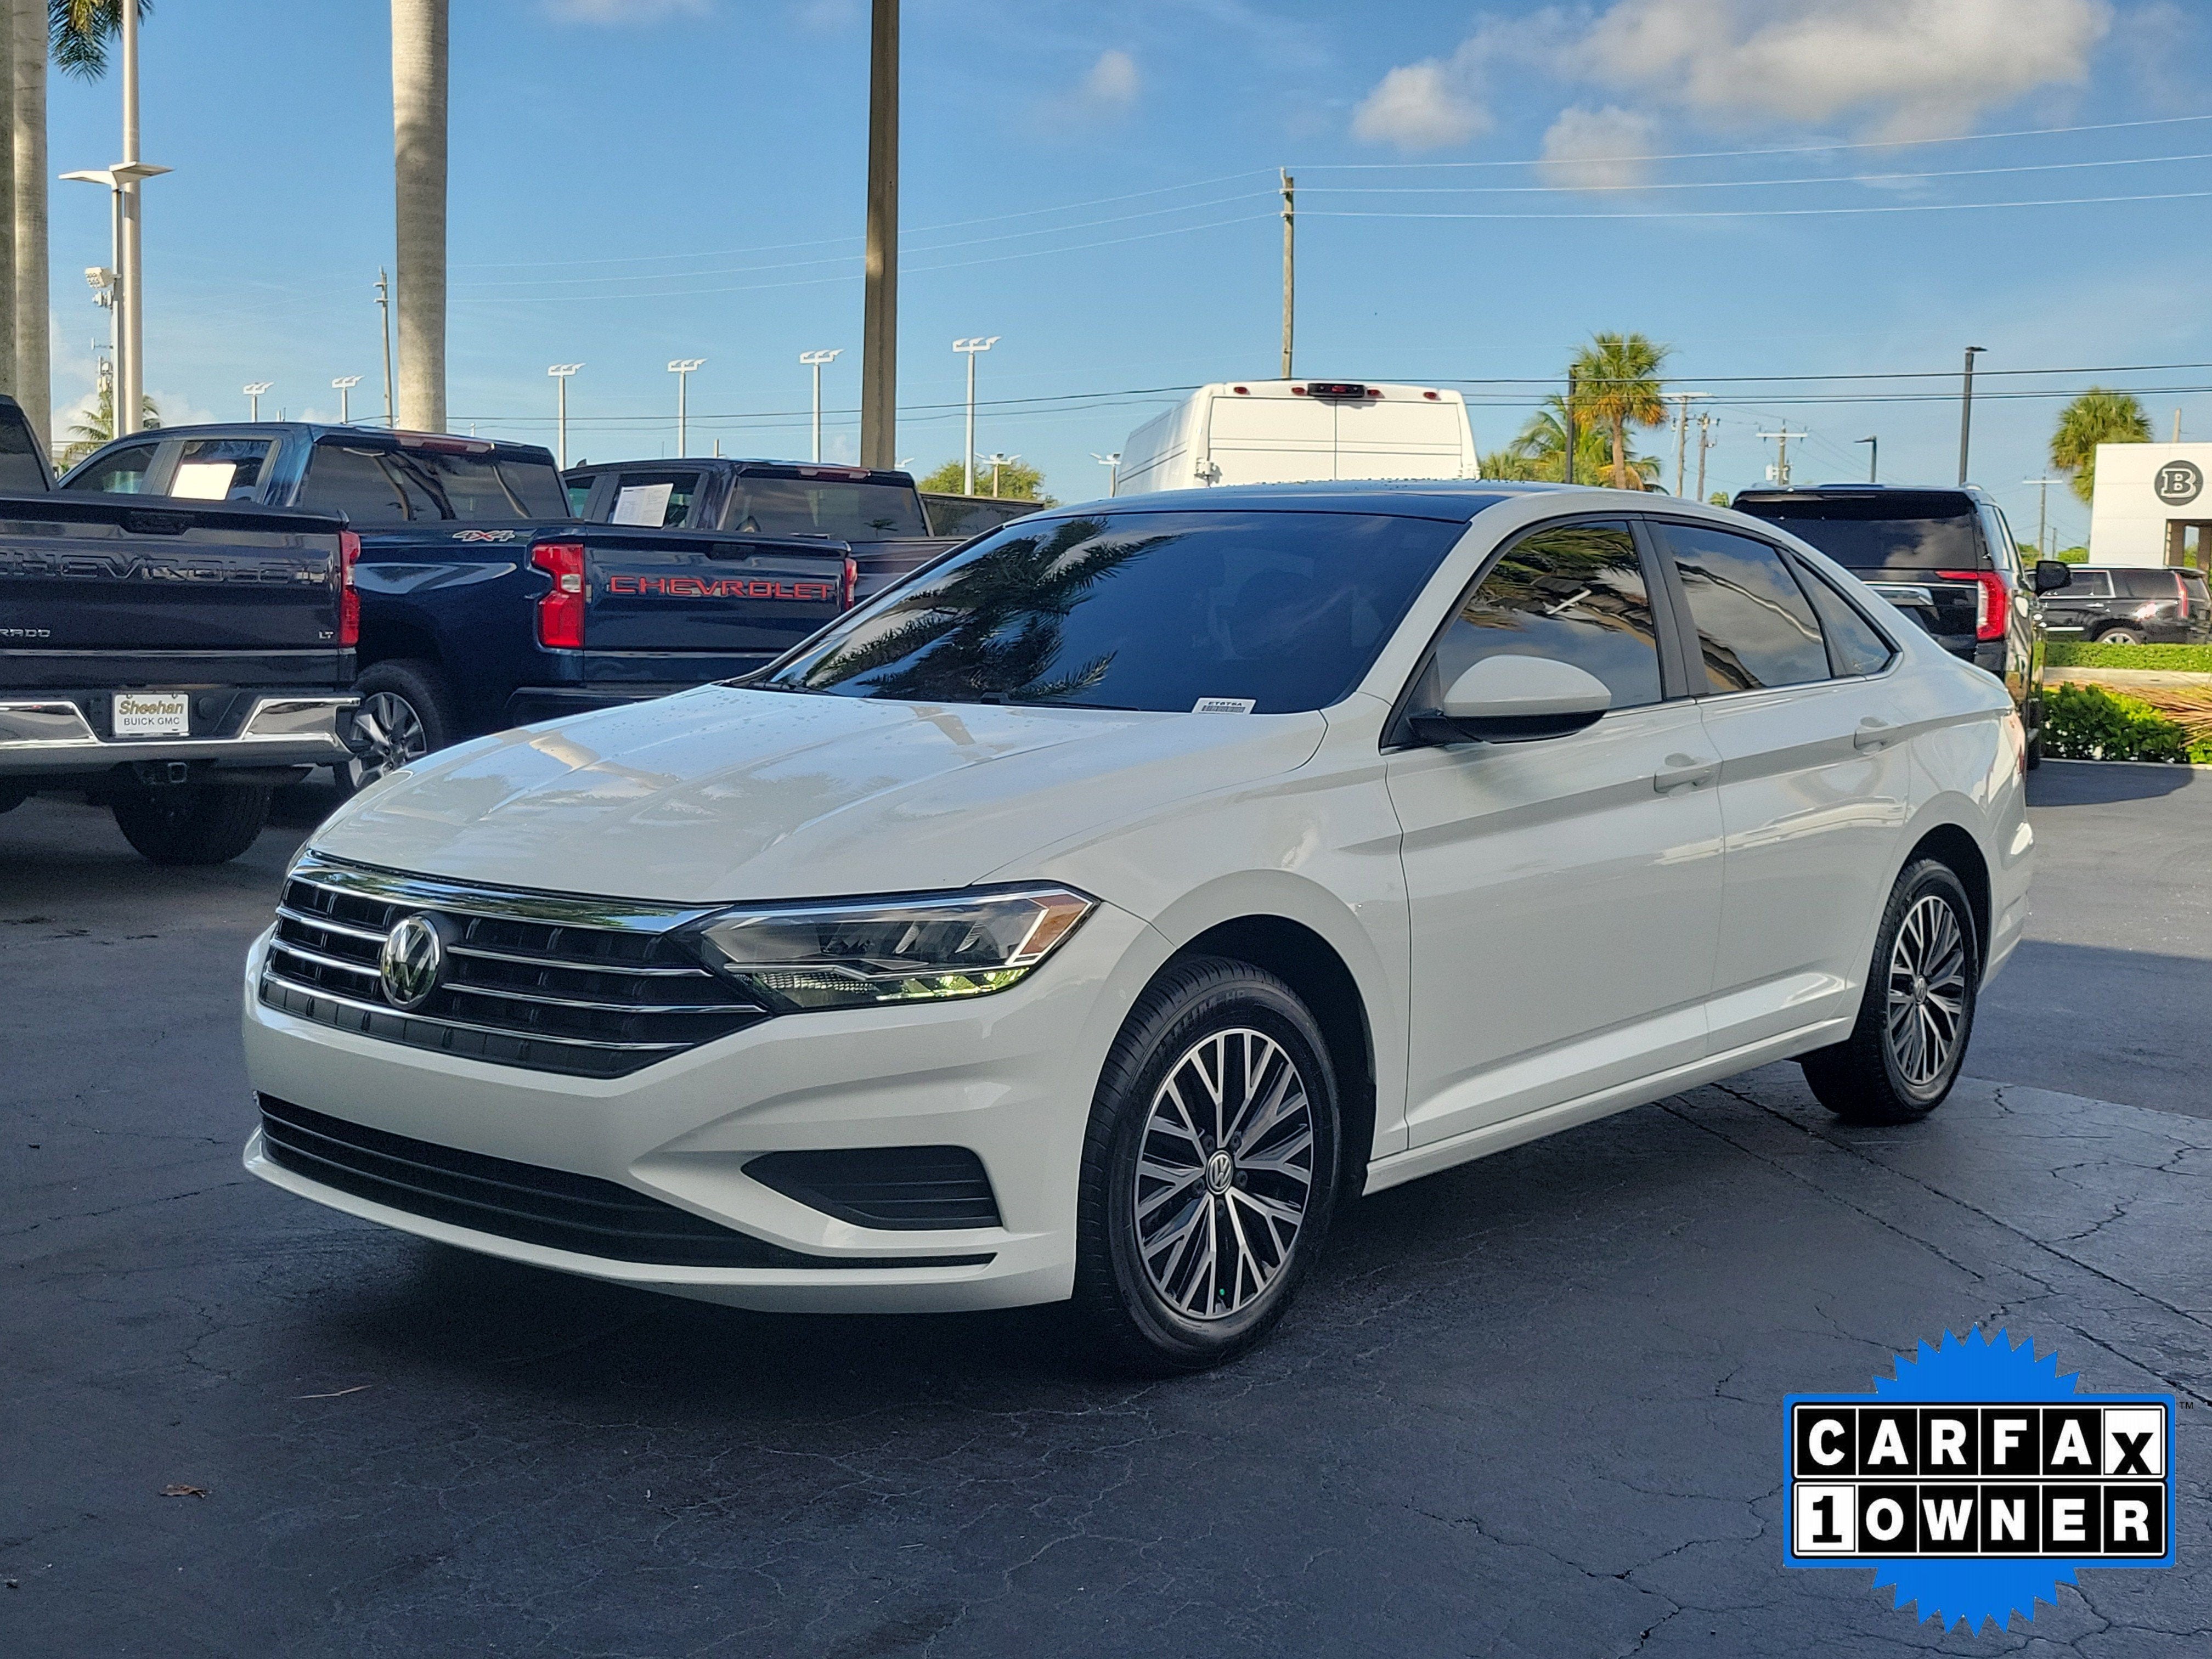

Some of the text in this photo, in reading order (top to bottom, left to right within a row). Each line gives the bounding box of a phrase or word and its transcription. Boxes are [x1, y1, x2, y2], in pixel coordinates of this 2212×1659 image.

[2161, 468, 2197, 498] B
[0, 551, 325, 583] HEVROLET
[610, 575, 832, 599] CHEVROLET
[319, 631, 334, 639] LT
[119, 700, 184, 715] Sheehan
[124, 717, 180, 725] BUICK GMC
